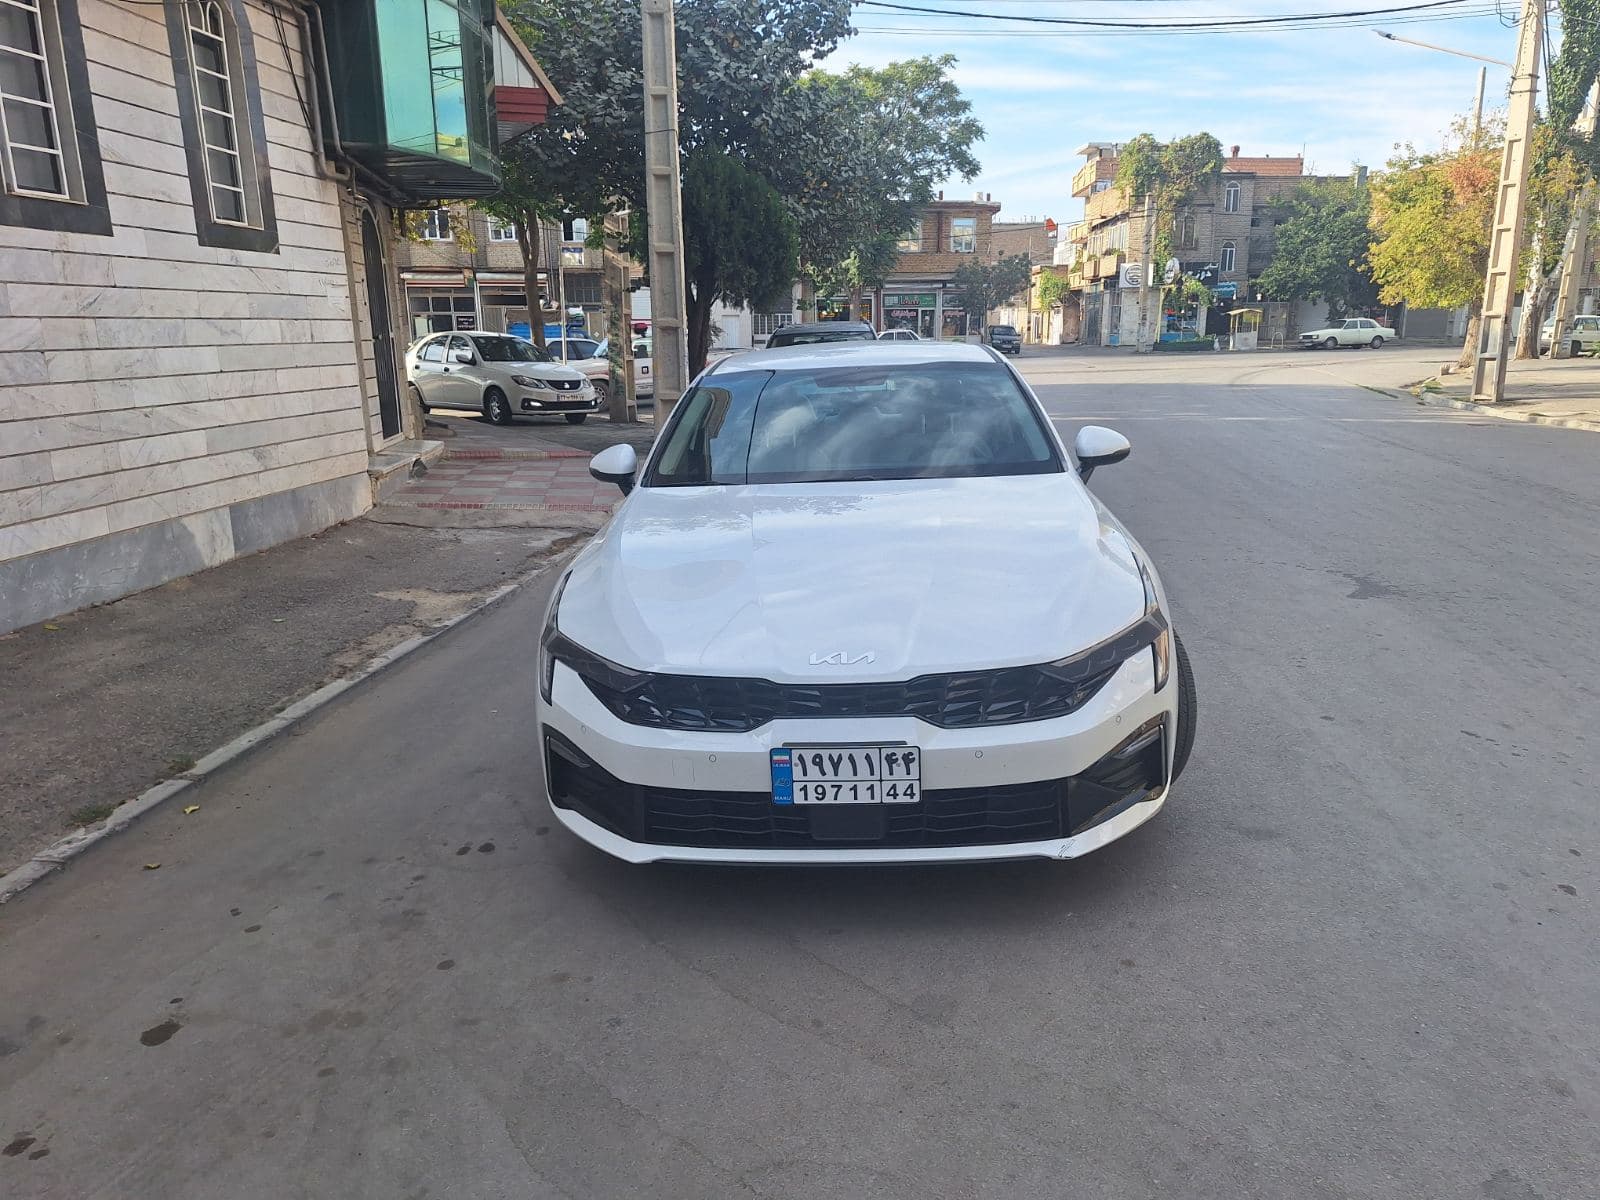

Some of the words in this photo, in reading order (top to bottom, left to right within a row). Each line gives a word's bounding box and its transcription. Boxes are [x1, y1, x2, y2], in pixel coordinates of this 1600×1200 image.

[797, 753, 875, 777] ۱۹۷۱۱
[884, 751, 916, 776] ۴۴
[799, 784, 875, 801] 19711
[886, 783, 916, 800] 44
